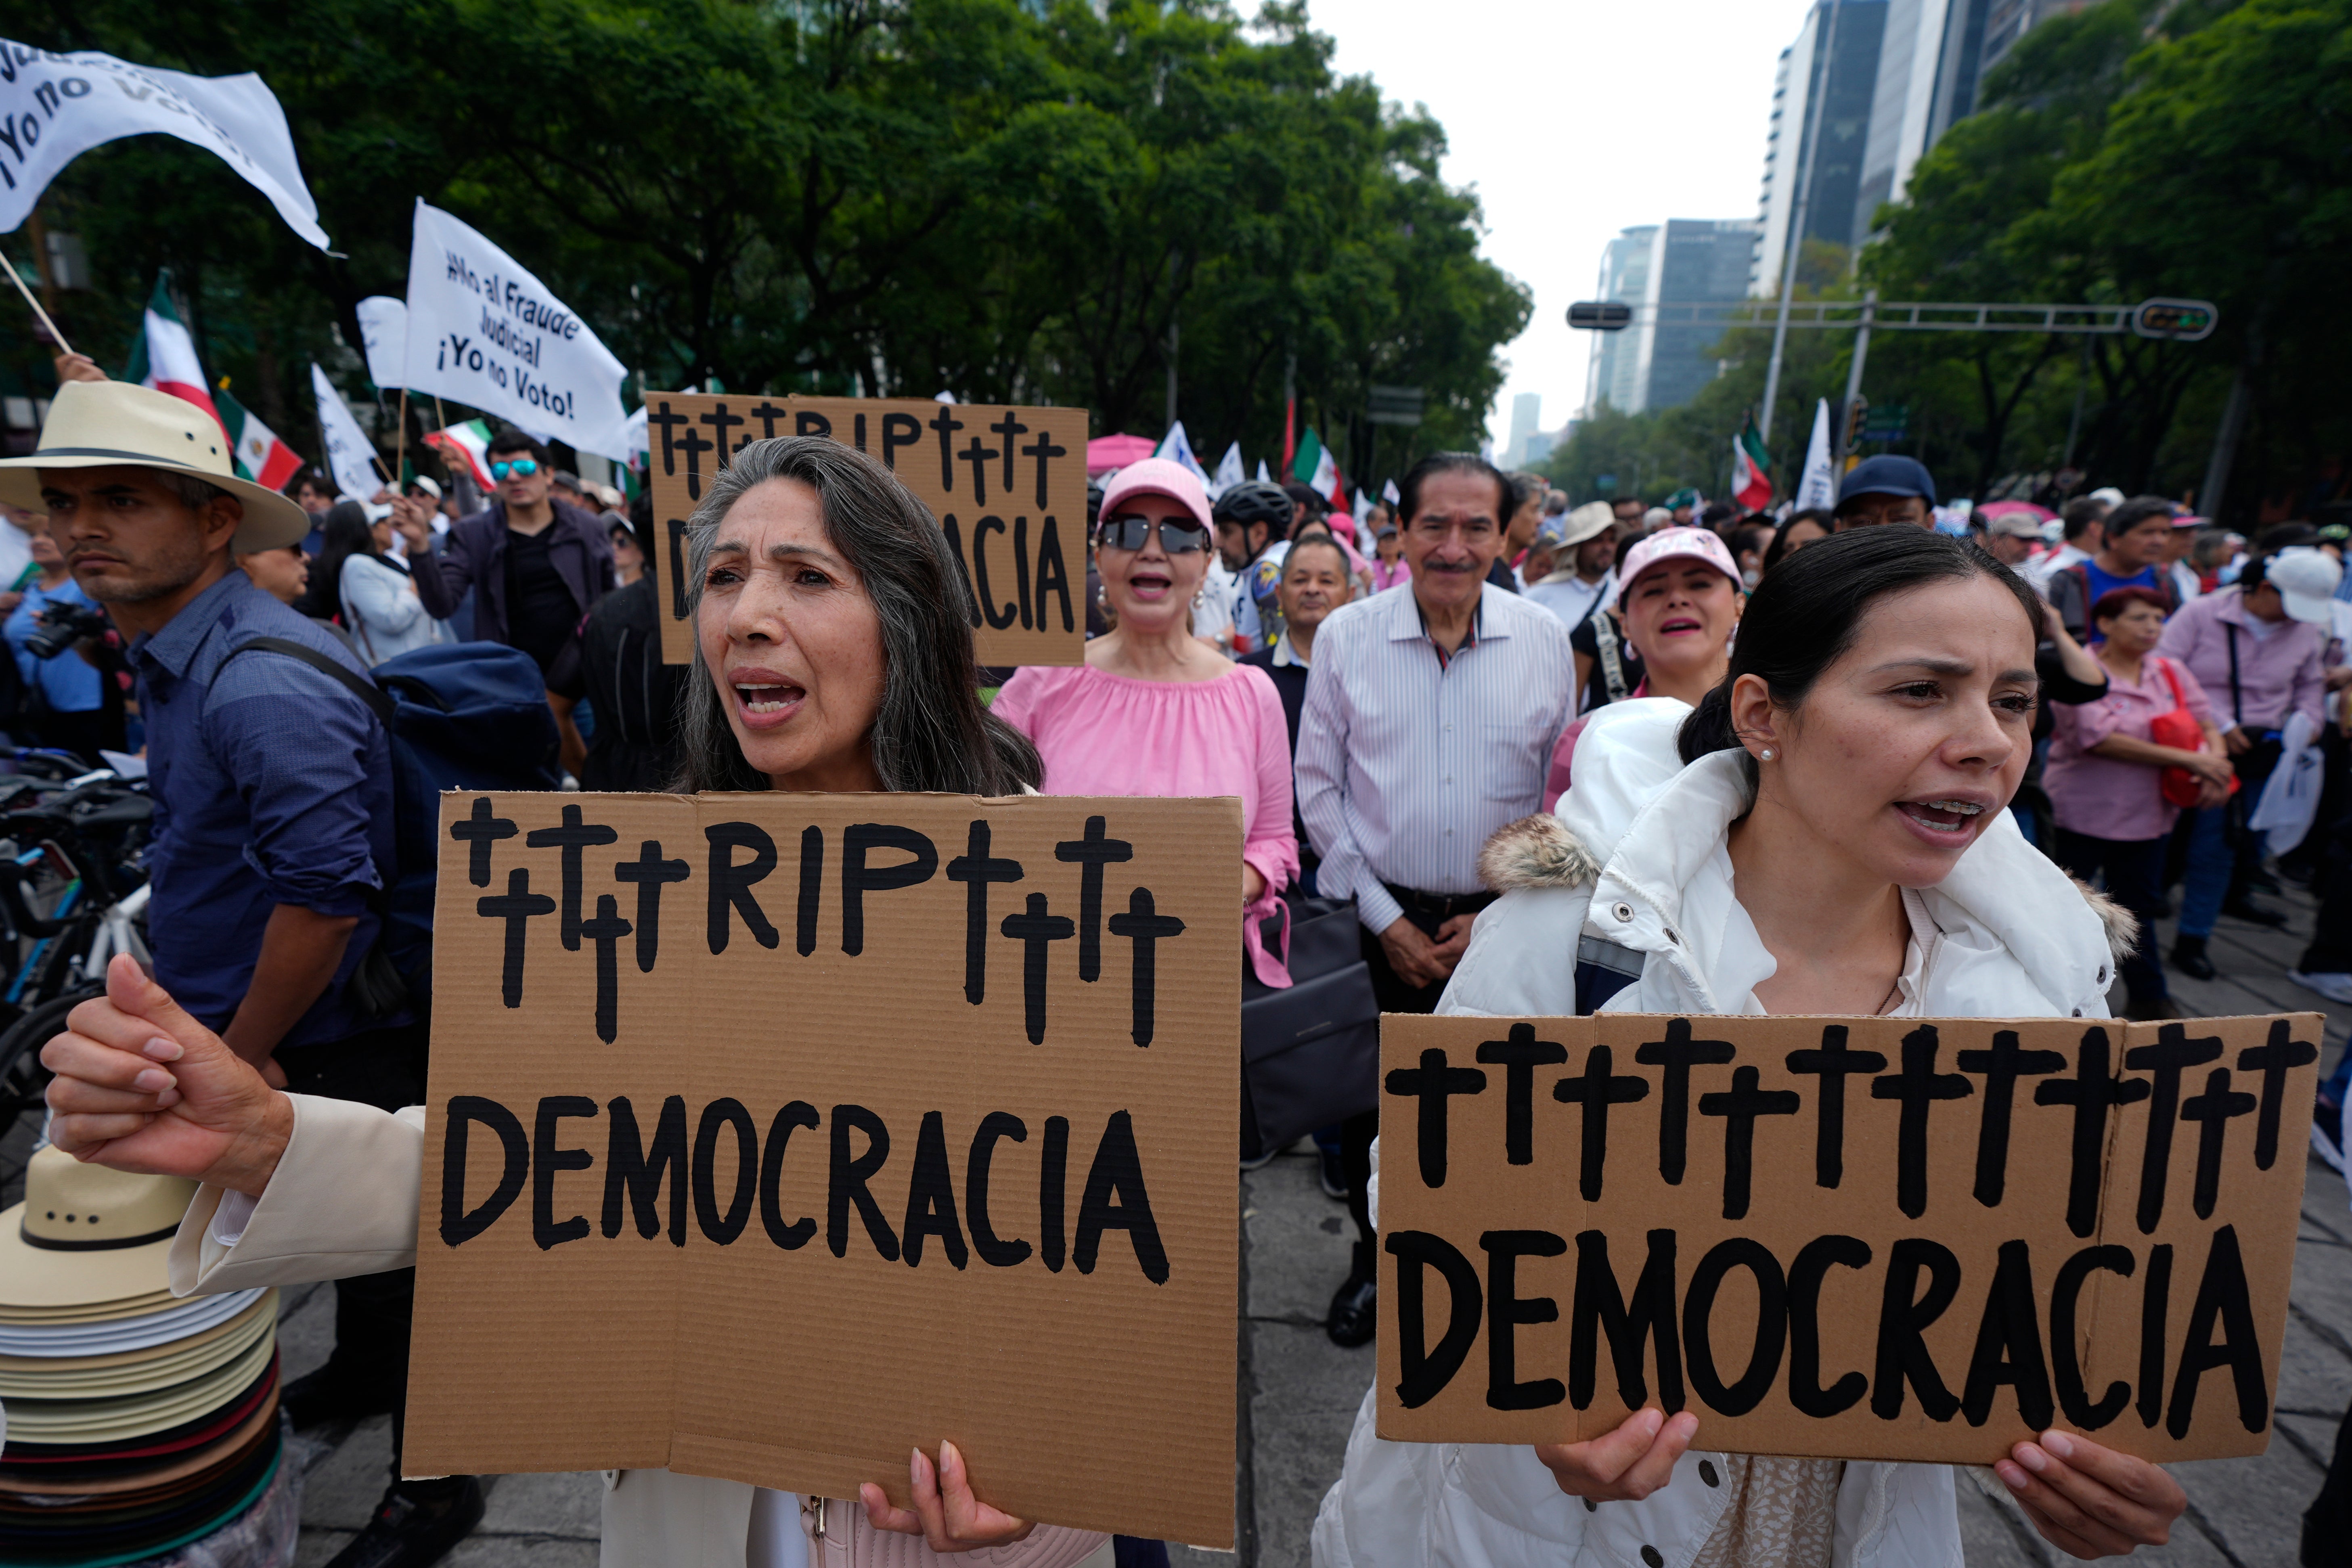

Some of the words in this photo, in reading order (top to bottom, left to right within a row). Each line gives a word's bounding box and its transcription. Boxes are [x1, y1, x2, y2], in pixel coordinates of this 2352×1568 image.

[34, 77, 92, 118] no
[446, 251, 480, 294] #No
[484, 273, 501, 306] al
[506, 281, 580, 341] Fraude
[480, 304, 541, 368] Judicial
[437, 333, 483, 371] ¡Yo
[488, 358, 507, 388] no
[515, 366, 574, 420] Voto!
[705, 822, 938, 957] RIP
[439, 1095, 1169, 1285] DEMOCRACIA
[1384, 1224, 2268, 1440] DEMOCRACIA
